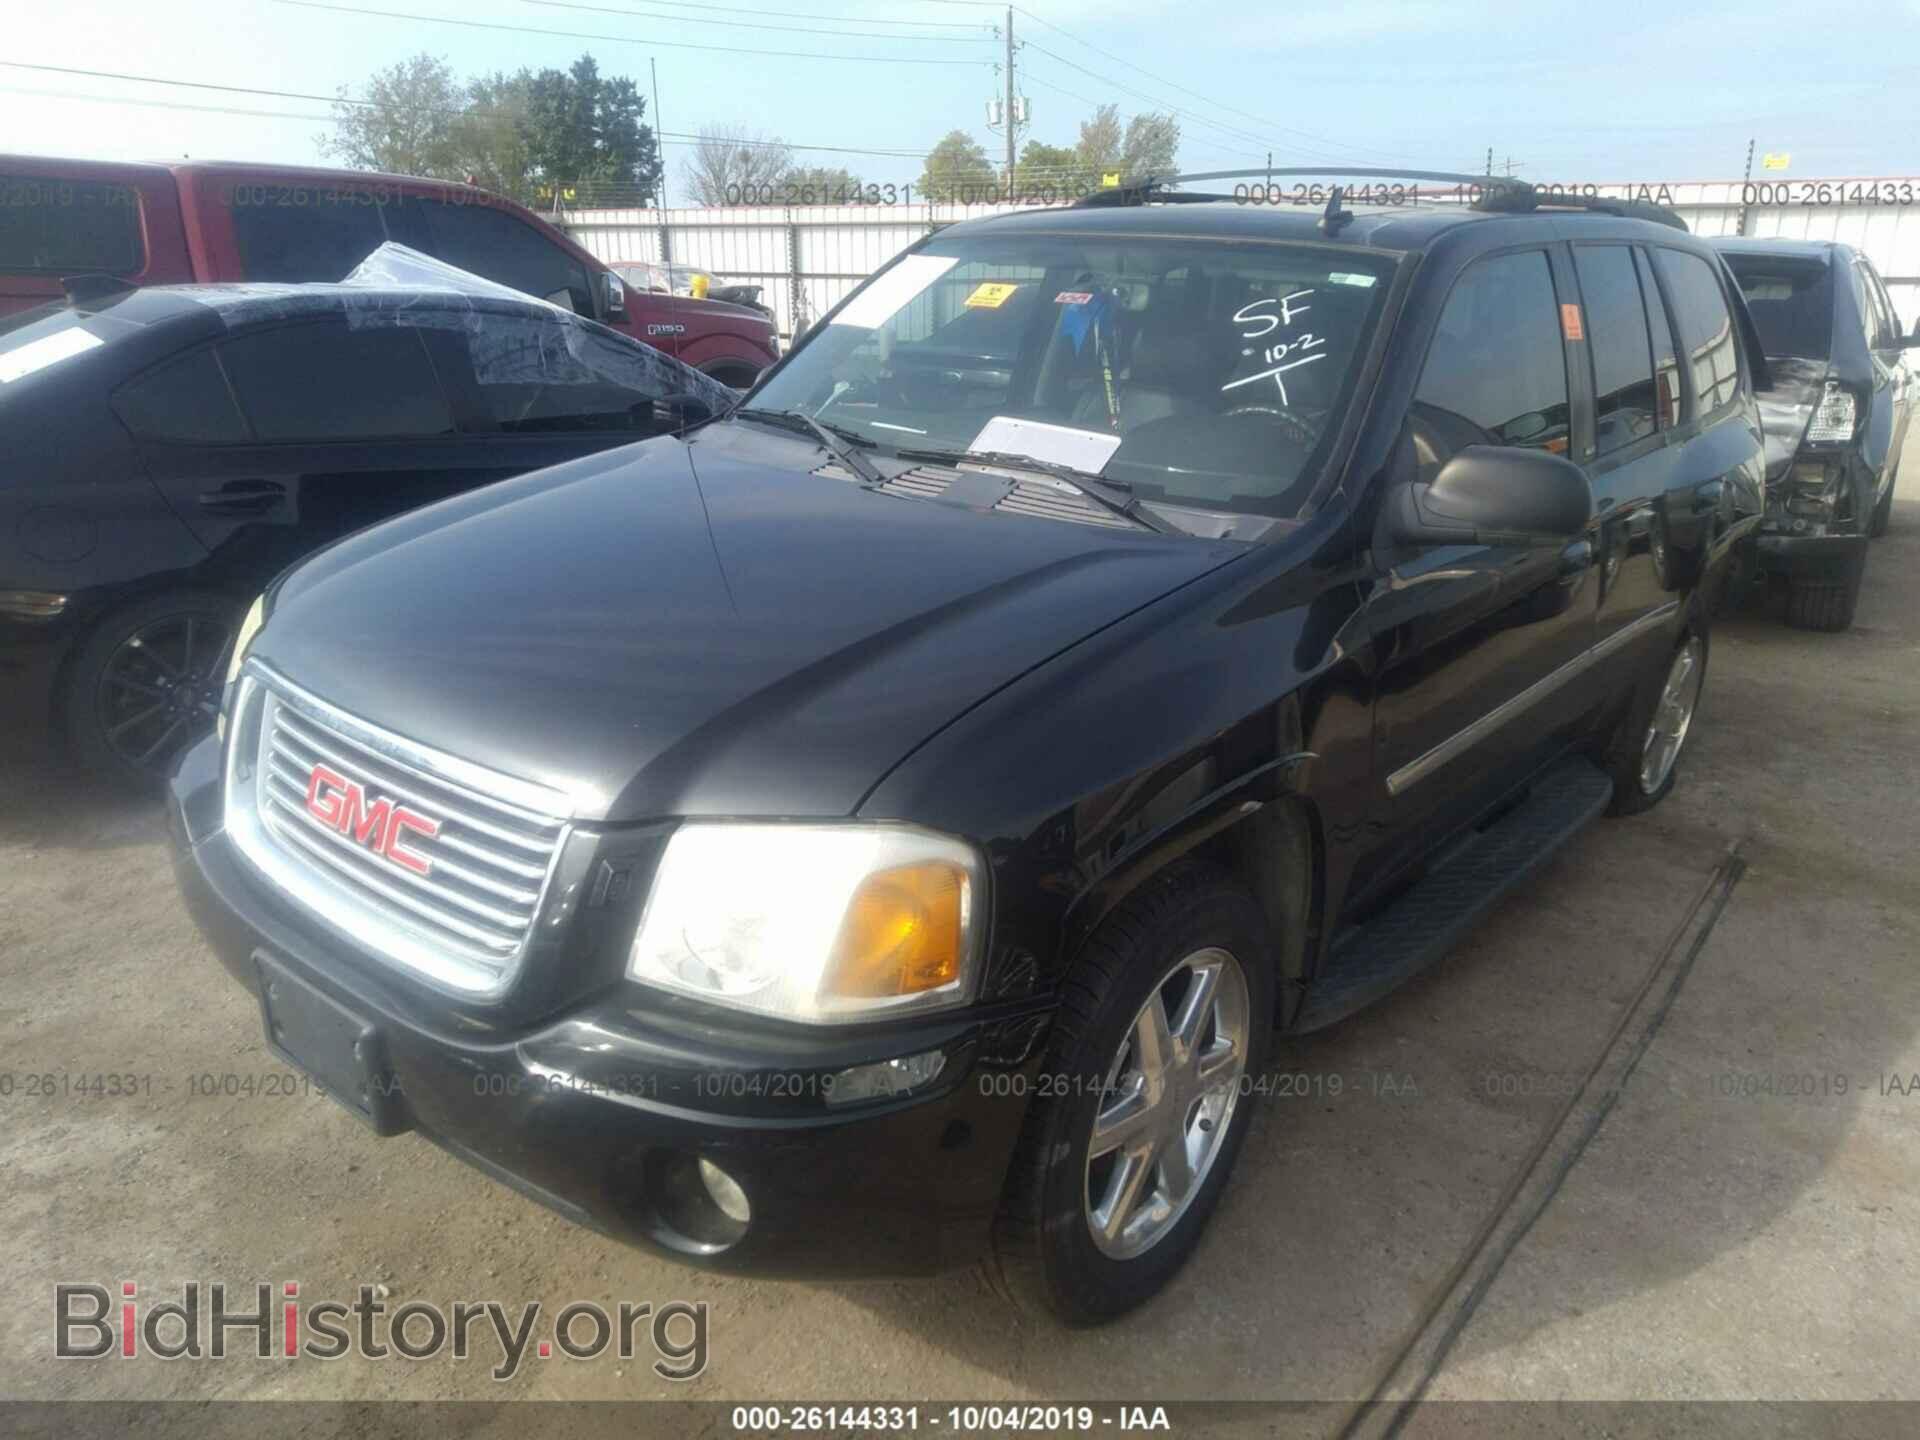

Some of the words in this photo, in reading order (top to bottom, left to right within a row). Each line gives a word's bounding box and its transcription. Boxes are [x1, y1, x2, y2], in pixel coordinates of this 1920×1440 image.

[1233, 289, 1315, 337] SF
[1265, 334, 1326, 363] 10-2
[304, 763, 442, 876] GMC
